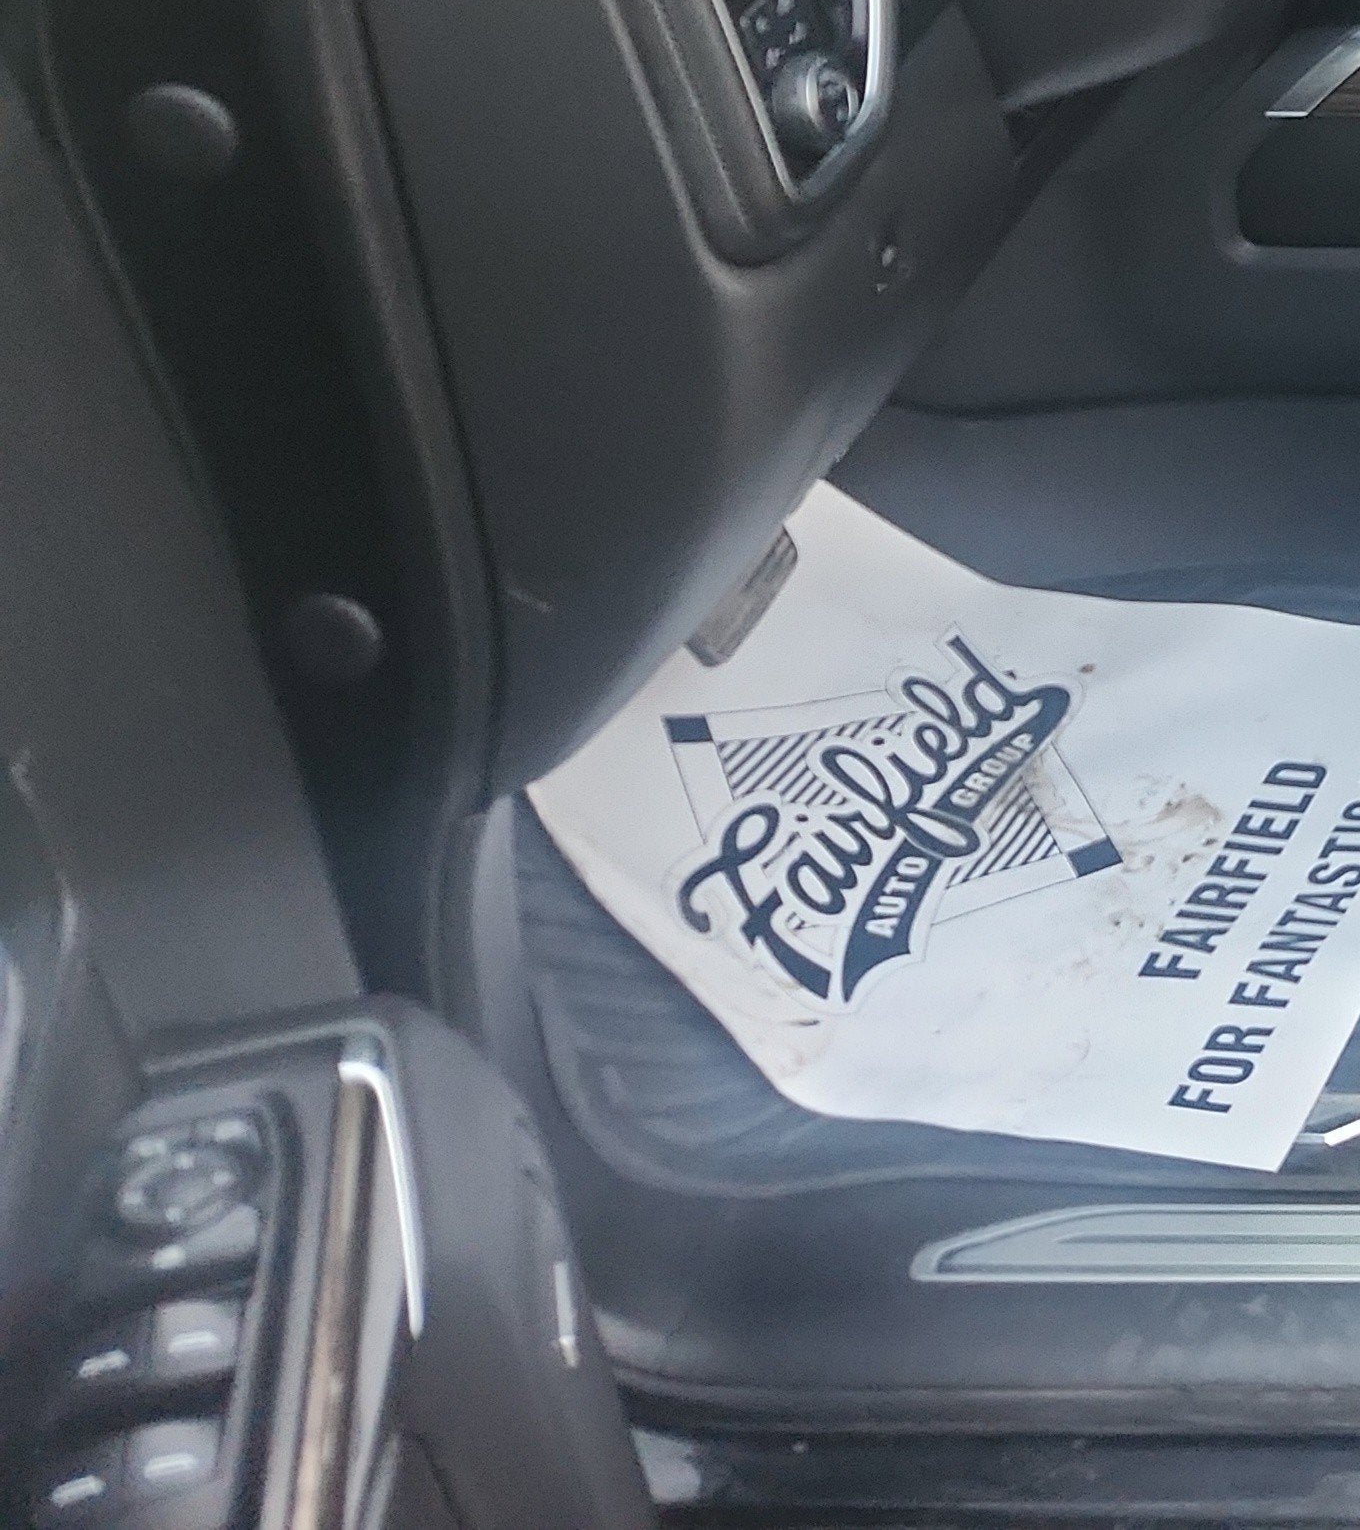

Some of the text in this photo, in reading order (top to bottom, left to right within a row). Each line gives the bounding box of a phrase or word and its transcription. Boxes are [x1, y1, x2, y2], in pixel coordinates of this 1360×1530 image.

[677, 635, 1045, 1000] Fairfield
[865, 732, 1037, 938] AUTO GROUP
[1138, 760, 1328, 980] FAIRFIELD
[1166, 1023, 1276, 1114] FOR
